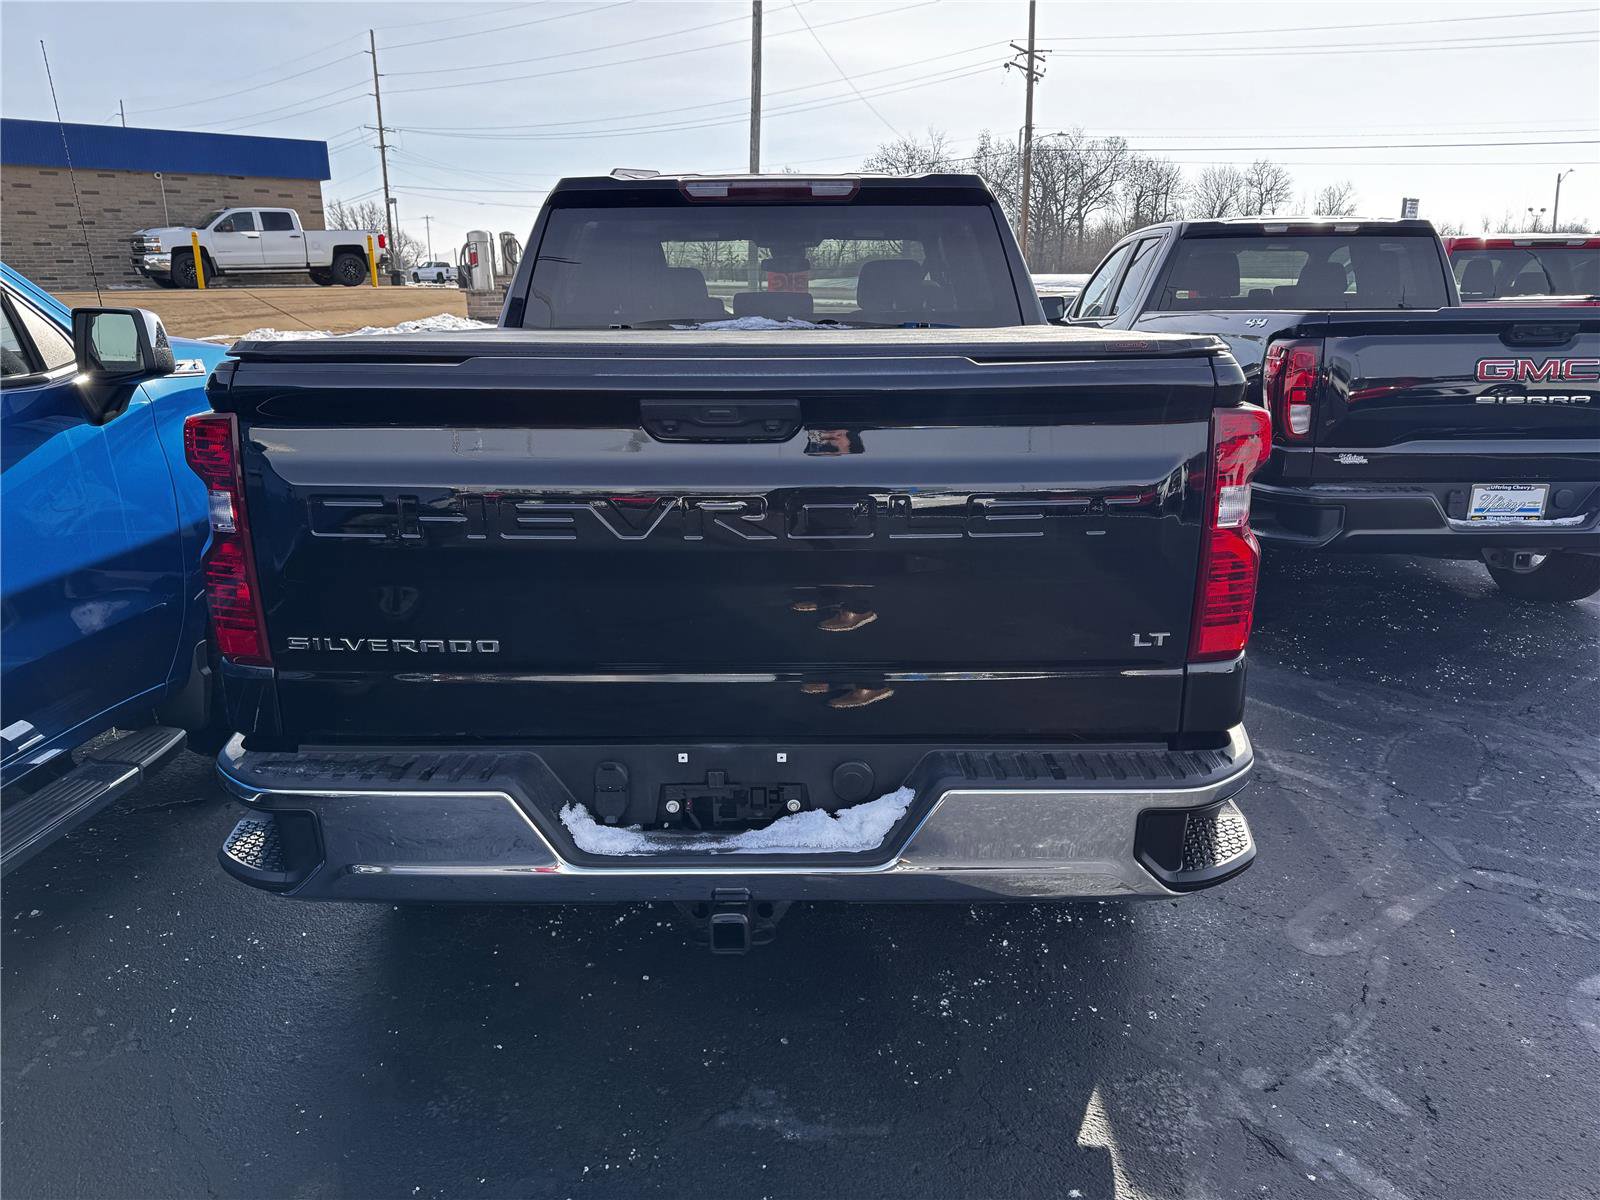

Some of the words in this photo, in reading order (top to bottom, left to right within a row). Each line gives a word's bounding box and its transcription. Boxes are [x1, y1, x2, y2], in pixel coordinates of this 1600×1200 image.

[1476, 357, 1600, 382] GMC
[1475, 395, 1592, 405] SIERRA
[307, 492, 1144, 540] CHEVROLET
[287, 636, 500, 653] SILVERADO
[1132, 632, 1171, 647] LT
